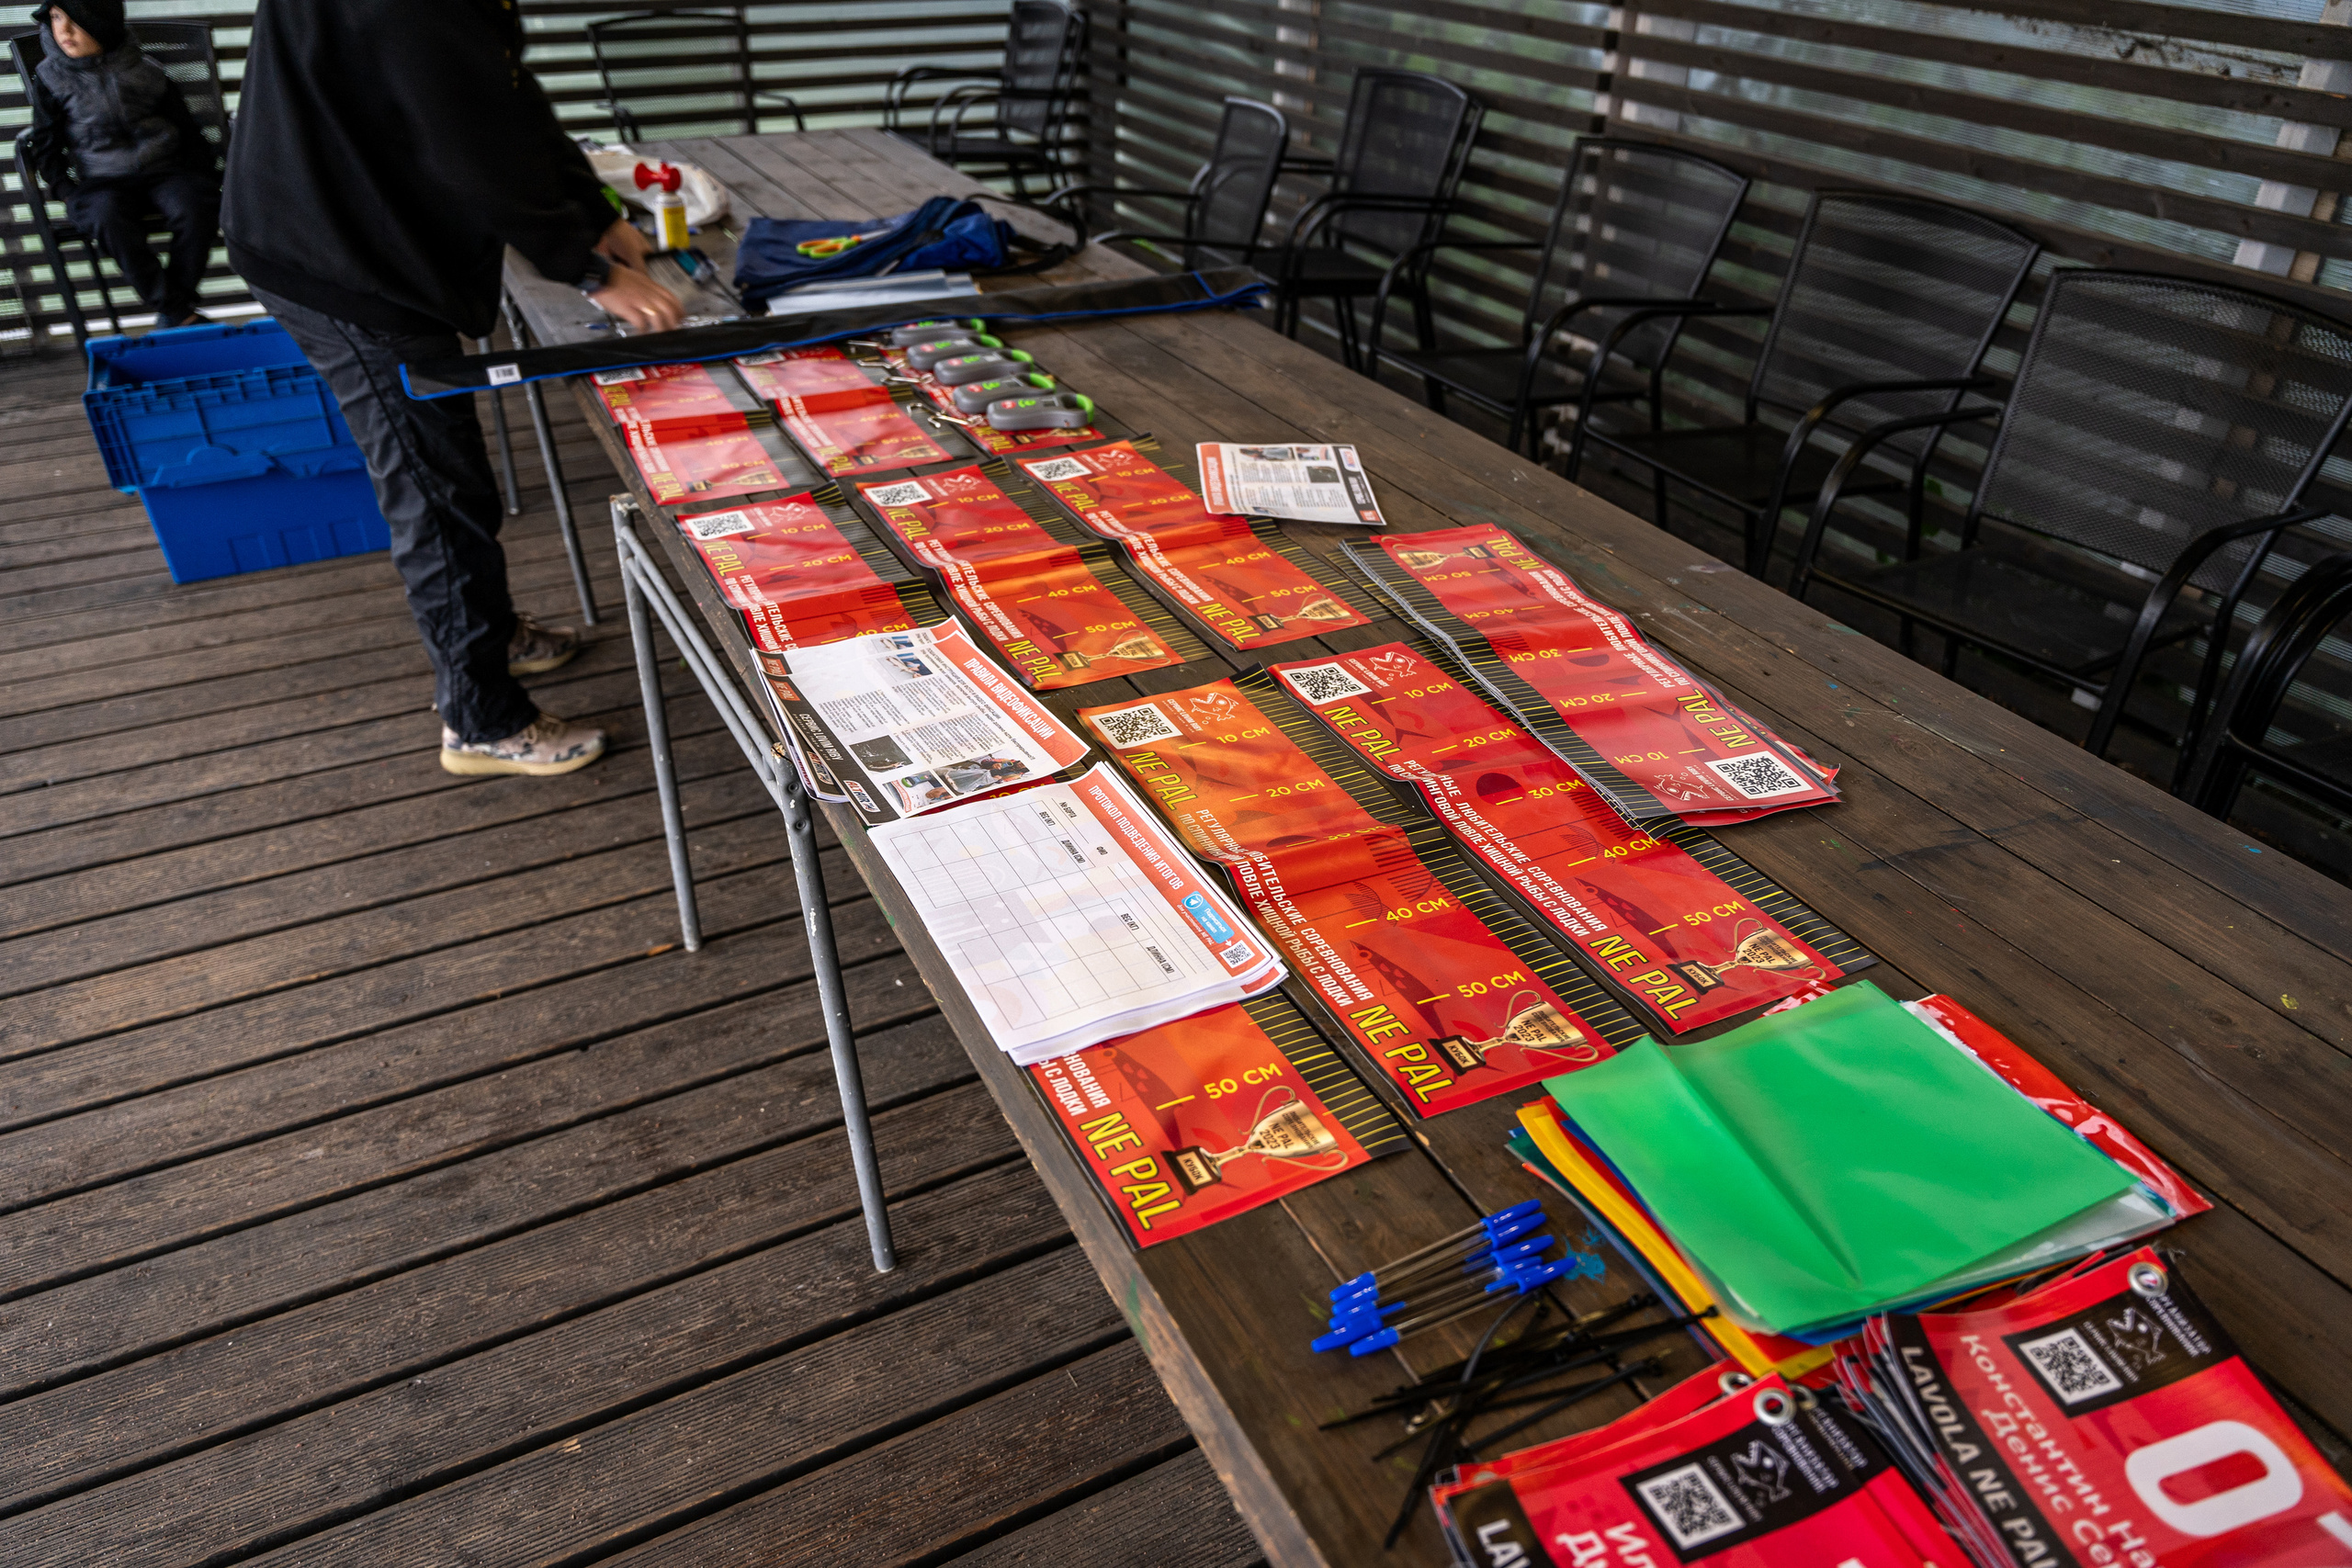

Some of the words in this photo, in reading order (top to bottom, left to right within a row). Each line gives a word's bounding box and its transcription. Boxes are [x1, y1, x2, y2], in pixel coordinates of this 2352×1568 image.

[1115, 469, 1132, 479] 10
[957, 494, 974, 503] 10
[1051, 481, 1080, 495] NE
[1066, 492, 1100, 513] PAL
[885, 508, 917, 522] NE
[781, 525, 797, 535] 10
[897, 520, 932, 541] PAL
[983, 525, 1003, 534] 20
[702, 540, 733, 555] NE
[1485, 535, 1527, 558] PAL
[711, 553, 746, 577] PAL
[801, 558, 823, 568] 20
[1226, 557, 1246, 566] 40
[1509, 556, 1545, 570] NE
[1048, 588, 1069, 599] 40
[1270, 588, 1292, 599] 50
[1085, 624, 1108, 634] 50
[1197, 603, 1236, 622] NE
[1219, 619, 1262, 644] PAL
[1003, 639, 1044, 660] NE
[1538, 649, 1563, 660] 30
[1020, 656, 1064, 683] PAL
[963, 658, 994, 688] ПРАВИЛА
[990, 682, 1057, 740] ВИДЕОФИКСАЦИИ
[1404, 689, 1424, 698] 10
[1591, 693, 1615, 704] 20
[1676, 689, 1728, 724] PAL
[1216, 734, 1238, 744] 10
[1324, 705, 1369, 730] NE
[1350, 729, 1402, 761] PAL
[1463, 737, 1487, 749] 20
[1707, 724, 1758, 750] NE
[1646, 750, 1670, 762] 10
[1125, 751, 1169, 774] NE
[1147, 774, 1198, 810] PAL
[845, 781, 869, 804] ALTAIR
[1266, 786, 1292, 797] 20
[1527, 786, 1554, 799] 30
[1178, 814, 1196, 825] ПО
[1088, 784, 1121, 821] ПРОТОКОЛ
[1115, 816, 1161, 863] ПОДВЕДЕНИЯ
[1154, 860, 1184, 891] ИТОГОВ
[1387, 764, 1406, 773] ПО
[1452, 821, 1487, 845] ЛОВЛЕ
[1478, 842, 1523, 876] ХИЩНОЙ
[1514, 875, 1551, 902] РЫБЫ
[1550, 908, 1591, 937] ЛОДКИ
[1602, 845, 1628, 860] 40
[1455, 803, 1531, 864] ЛЮБИТЕЛЬСКИЕ
[1527, 866, 1608, 932] СОРЕВНОВАНИЯ
[1235, 860, 1265, 899] ЛОВЛЕ
[1255, 898, 1296, 940] ХИЩНОЙ
[1385, 908, 1413, 922] 40
[1683, 911, 1713, 926] 50
[1199, 930, 1209, 940] NE
[1245, 851, 1308, 926] ЮБИТЕЛЬСКИЕ
[1301, 927, 1374, 1001] СОРЕВНОВАНИЯ
[1285, 937, 1319, 967] РЫБЫ
[1742, 948, 1766, 964] 2023
[1749, 943, 1764, 954] NE
[1758, 952, 1777, 964] PAL
[1309, 965, 1325, 975] С
[1589, 933, 1648, 973] NE
[1628, 969, 1700, 1021] PAL
[1687, 967, 1710, 985] КУБОК
[1316, 974, 1354, 1007] ЛОДКИ
[1456, 981, 1488, 998] 50
[1514, 1024, 1536, 1042] 2023
[1521, 1020, 1535, 1032] NE
[1531, 1029, 1548, 1042] PAL
[1349, 1003, 1409, 1045] NE
[1385, 1042, 1456, 1104] PAL
[1449, 1043, 1470, 1065] КУБОК
[1045, 1067, 1062, 1078] С
[1049, 1077, 1088, 1117] ЛОДКИ
[1204, 1077, 1238, 1100] 50
[1080, 1111, 1143, 1160] NE
[1260, 1129, 1281, 1149] 2023
[1269, 1122, 1284, 1136] NE
[1276, 1133, 1295, 1149] PAL
[1183, 1157, 1205, 1181] КУБОК
[1110, 1156, 1182, 1230] PAL
[1901, 1347, 1981, 1464] LAVOLA
[1970, 1468, 2018, 1513] NE
[1961, 1333, 2109, 1516] Константин
[1982, 1409, 2074, 1514] Денис
